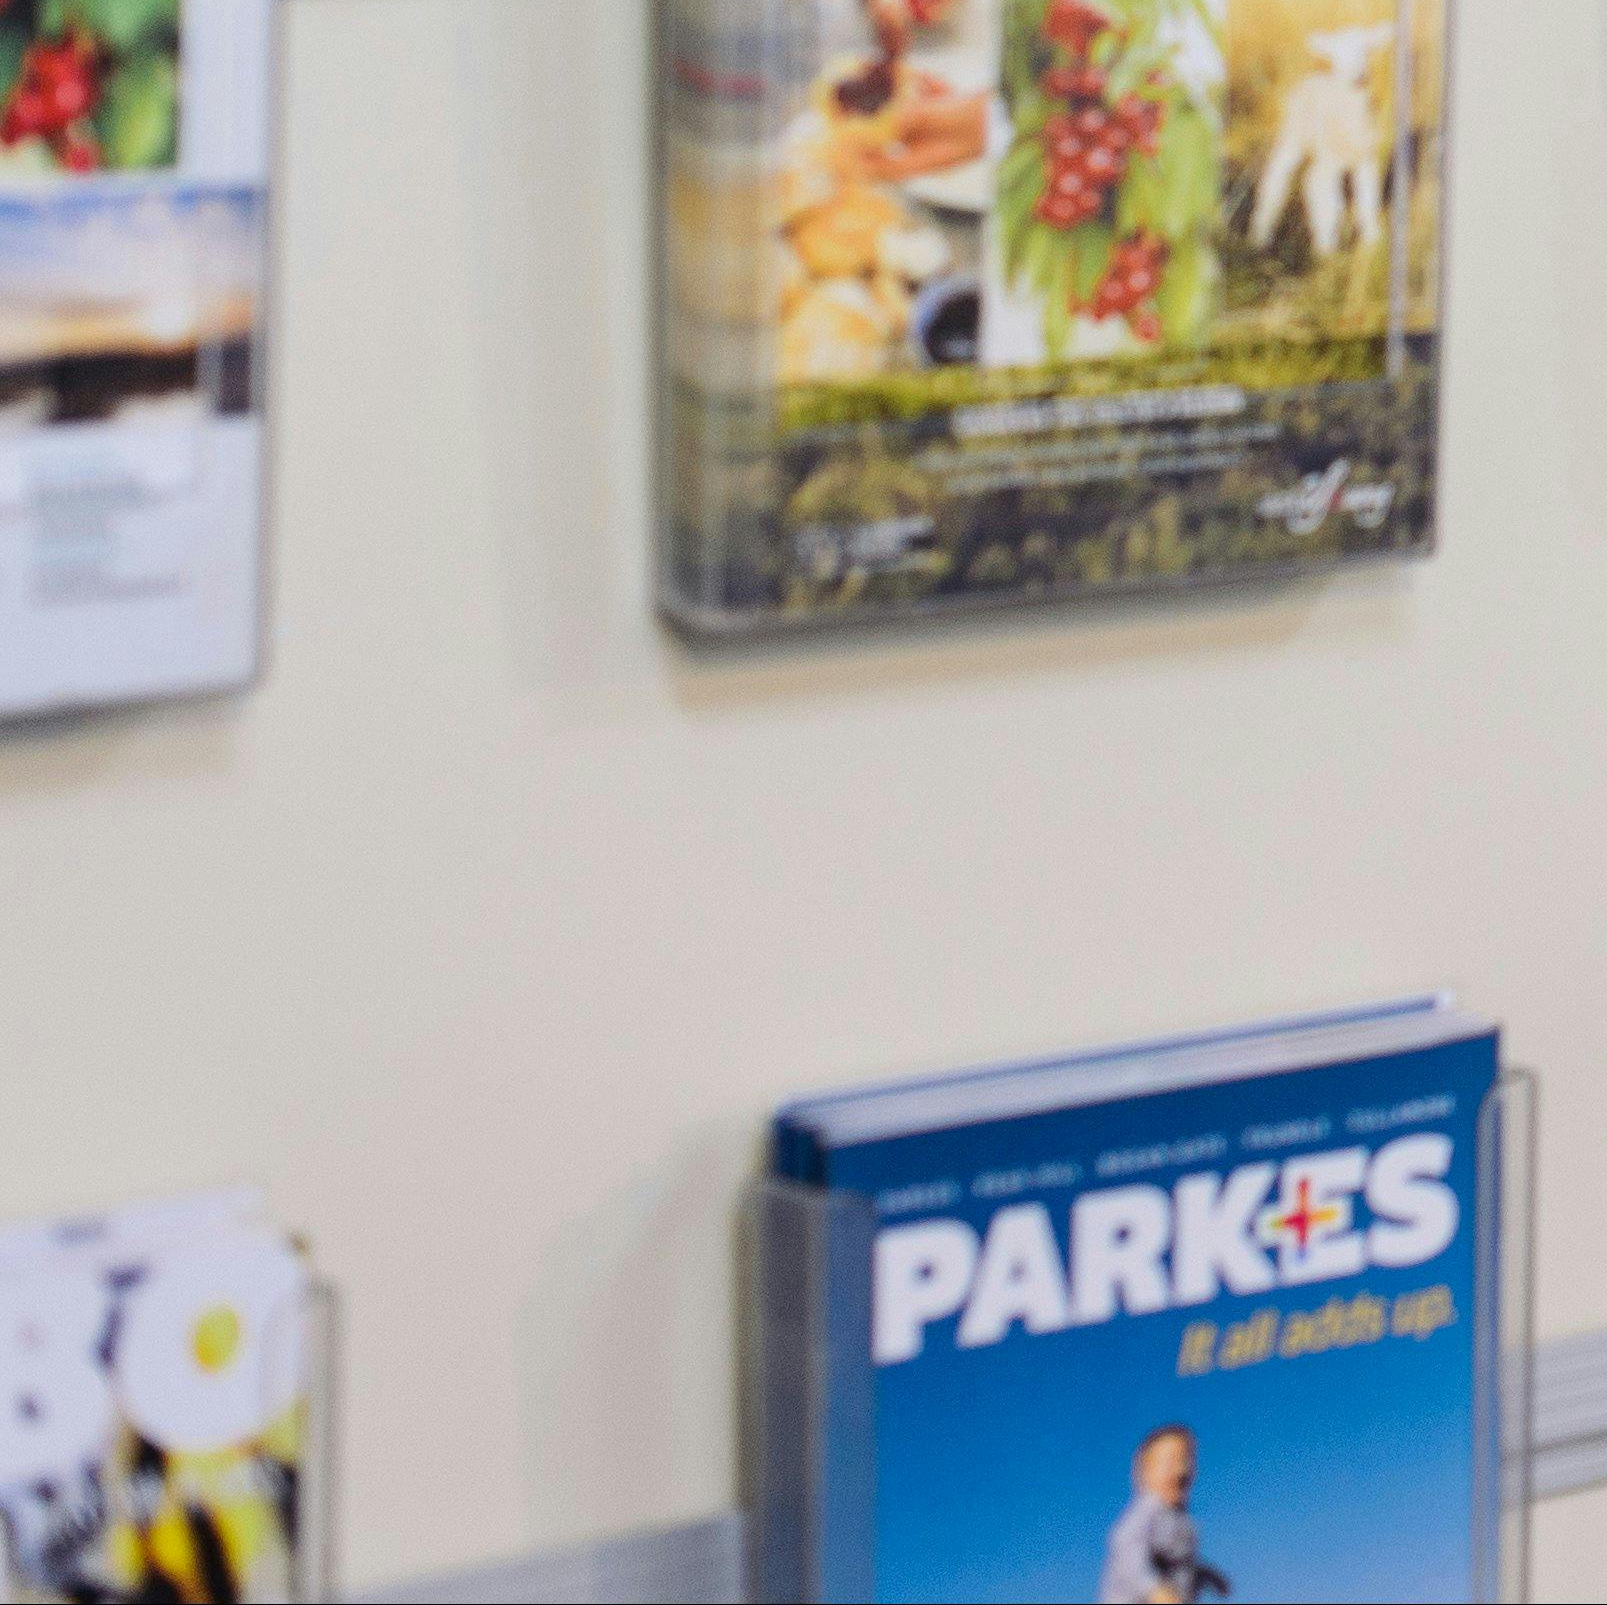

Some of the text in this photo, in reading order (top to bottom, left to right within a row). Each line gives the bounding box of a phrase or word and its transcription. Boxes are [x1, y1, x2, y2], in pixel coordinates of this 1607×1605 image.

[871, 1132, 1460, 1366] PARKES
[1177, 1282, 1457, 1376] It all adds up.
